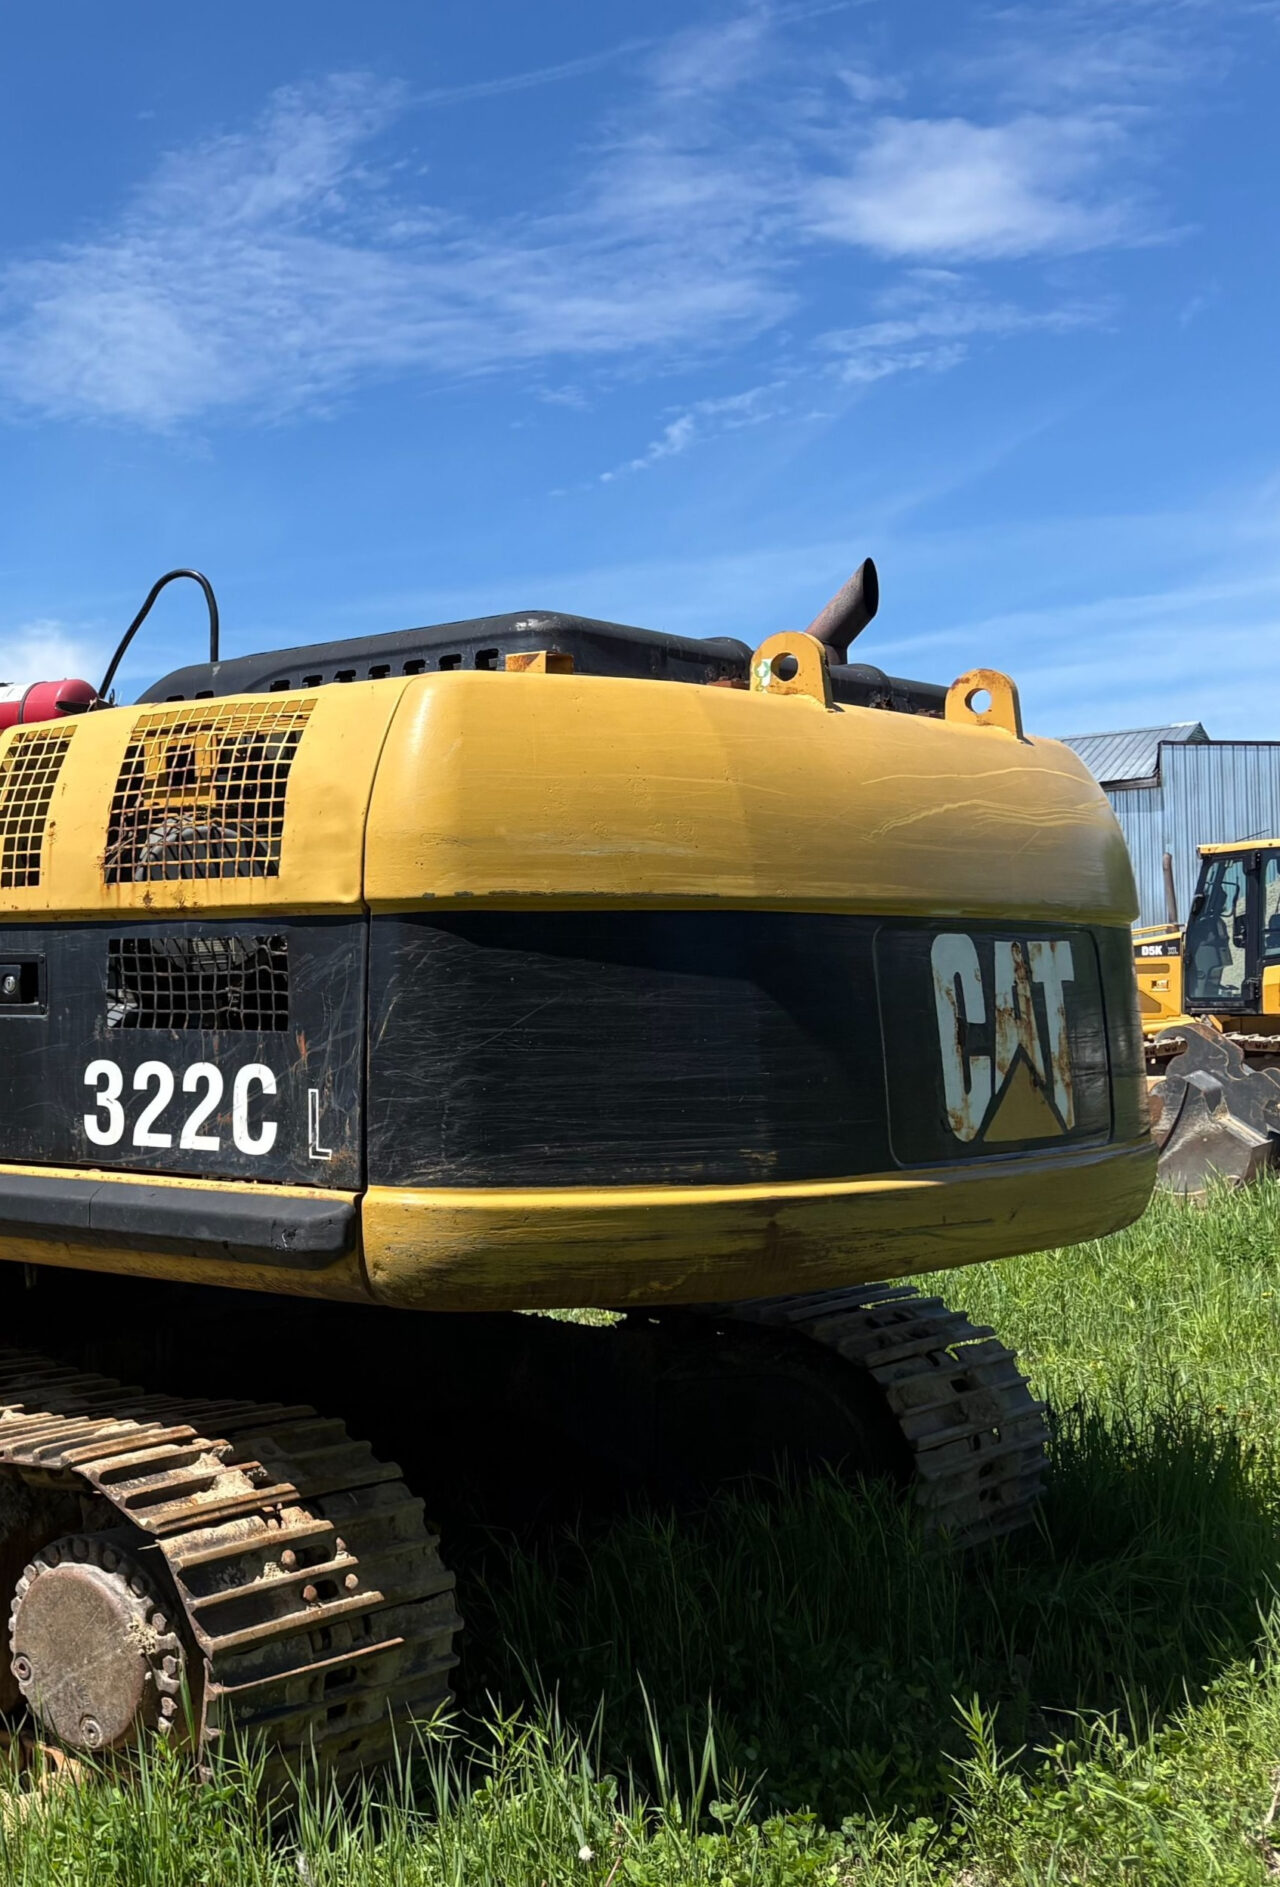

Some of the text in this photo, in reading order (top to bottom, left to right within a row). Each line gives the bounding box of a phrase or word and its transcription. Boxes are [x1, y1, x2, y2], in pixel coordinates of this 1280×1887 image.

[1141, 945, 1163, 956] D5K
[930, 933, 1075, 1142] CAT
[83, 1059, 332, 1160] 322C L
